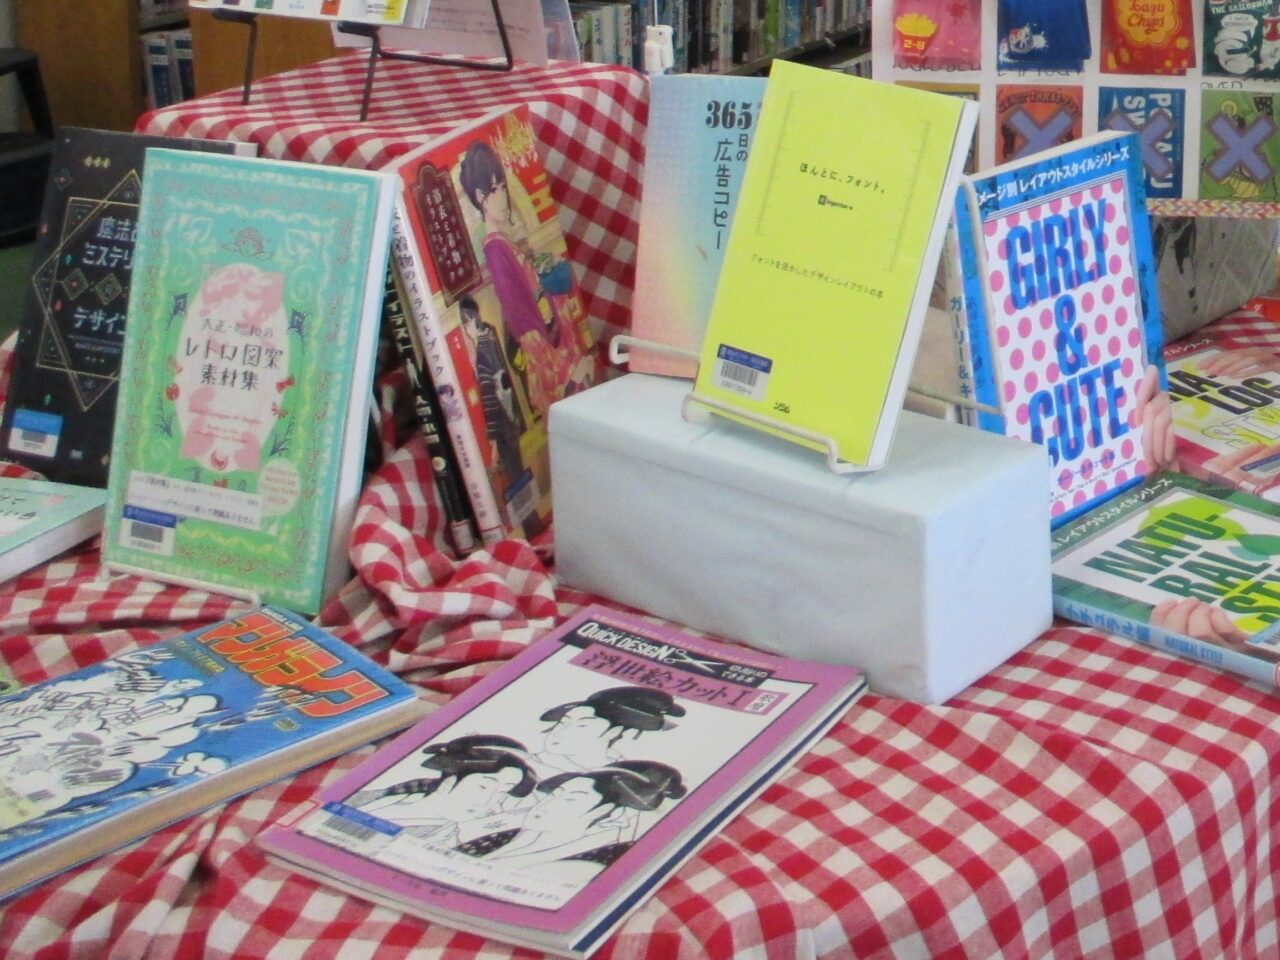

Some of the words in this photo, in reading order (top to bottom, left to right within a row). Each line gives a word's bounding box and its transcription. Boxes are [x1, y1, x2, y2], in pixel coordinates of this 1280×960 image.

[706, 101, 753, 130] 365
[714, 139, 734, 250] 広告コピー
[799, 162, 886, 194] ほんとに、フォント。
[1006, 197, 1109, 311] GIRLY
[186, 337, 284, 369] レトロ図案
[1054, 294, 1090, 376] &
[201, 363, 258, 391] 素材集
[1028, 357, 1129, 464] CUTE
[1082, 511, 1222, 584] NATU-
[1148, 550, 1273, 604] RAL
